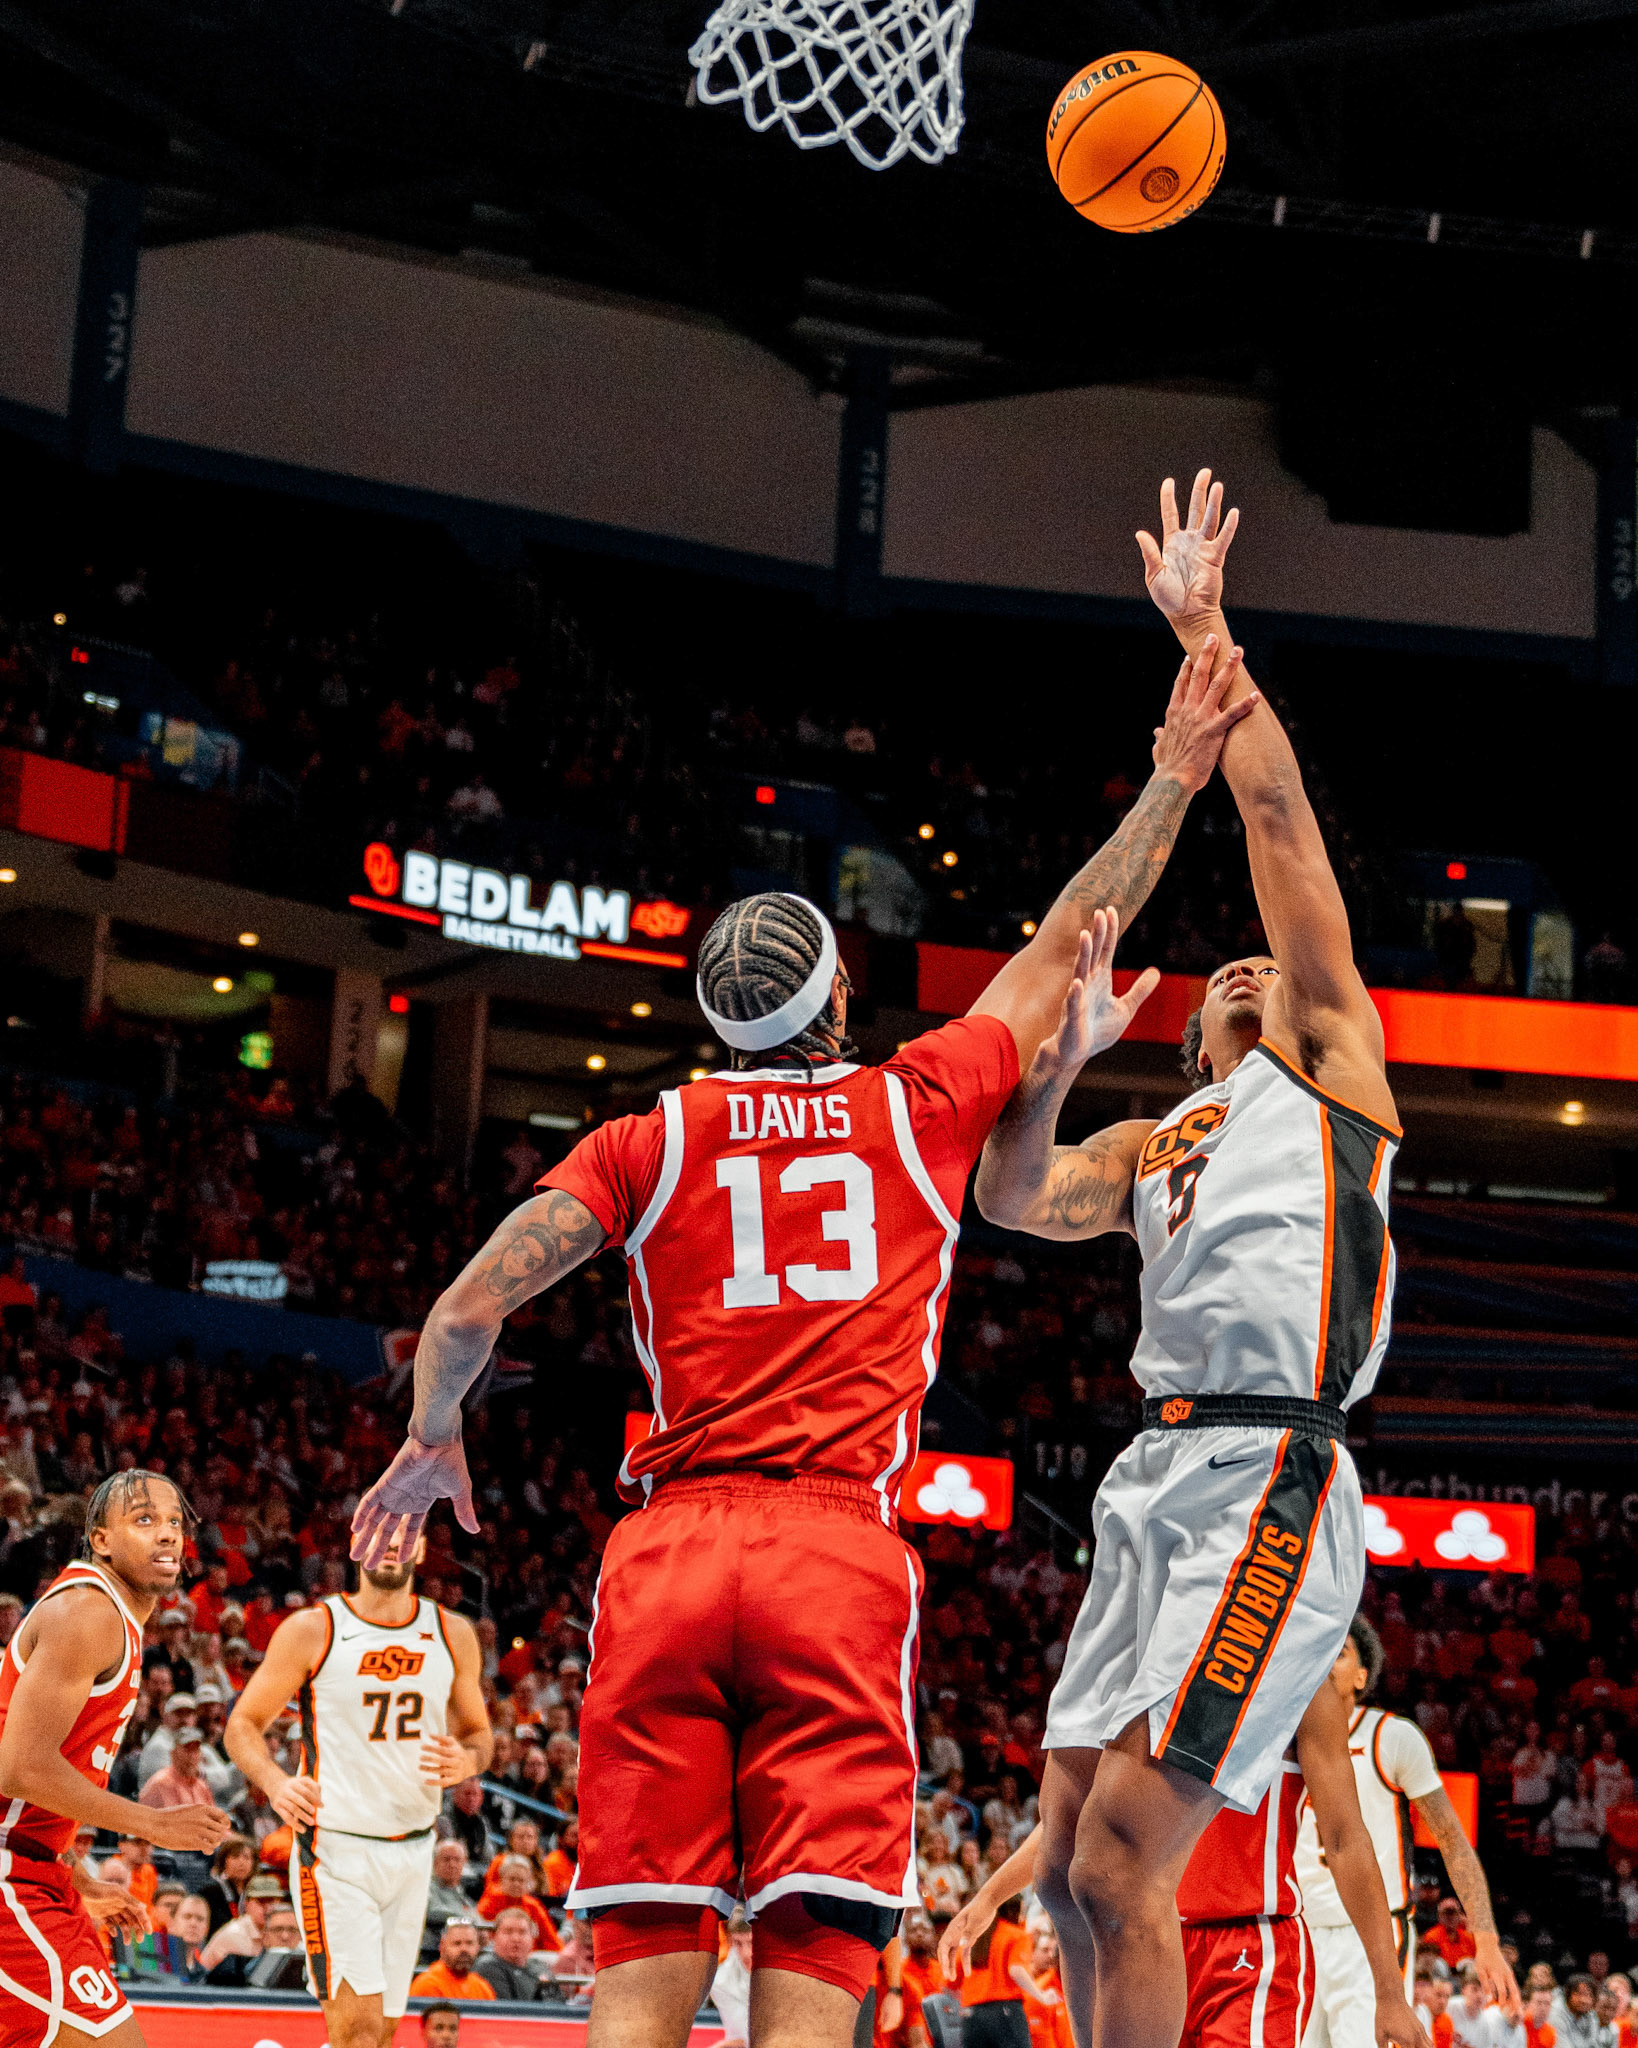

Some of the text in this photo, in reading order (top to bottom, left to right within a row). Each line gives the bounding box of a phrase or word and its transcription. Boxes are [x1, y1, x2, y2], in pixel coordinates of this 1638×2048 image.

[1049, 59, 1141, 141] Wilson
[402, 851, 630, 943] BEDLAM
[443, 913, 581, 961] BASKETBALL
[726, 1093, 852, 1140] DAVIS
[715, 1151, 879, 1309] 13
[1161, 1398, 1194, 1424] OSU
[1204, 1524, 1303, 1695] COWBOYS
[356, 1645, 426, 1682] OSU
[362, 1691, 424, 1742] 72
[300, 1865, 323, 1955] COWBOYS
[68, 1964, 118, 2011] OU
